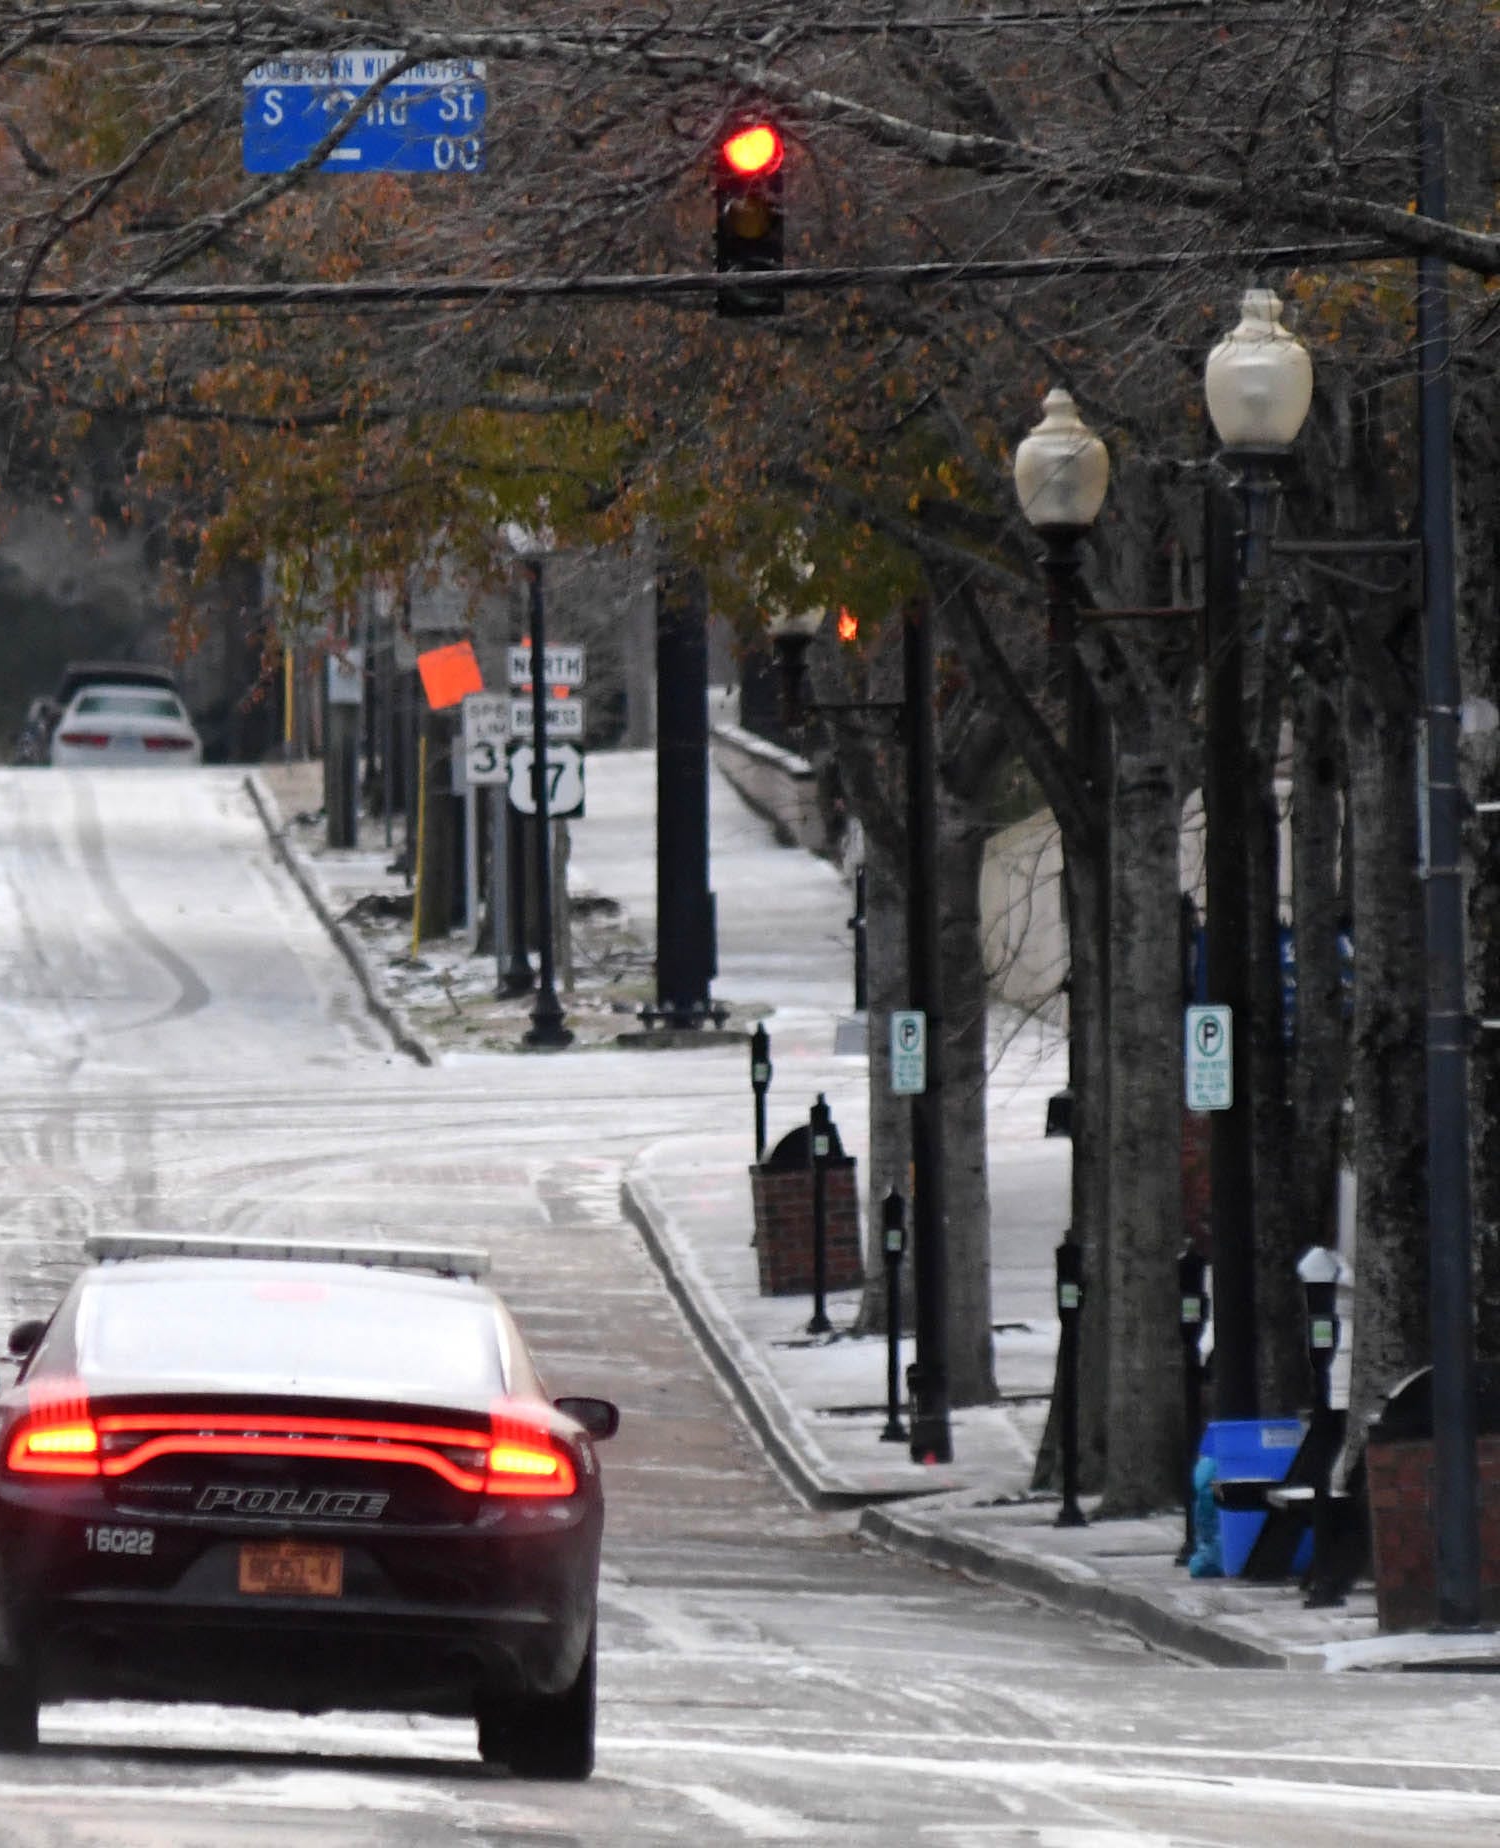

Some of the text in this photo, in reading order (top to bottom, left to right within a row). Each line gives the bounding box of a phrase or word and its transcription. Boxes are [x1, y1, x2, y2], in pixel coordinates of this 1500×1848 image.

[263, 89, 284, 126] S
[438, 88, 475, 122] St
[513, 656, 580, 676] NRTH
[1203, 1022, 1219, 1050] P
[196, 1486, 390, 1518] POLICE
[84, 1527, 155, 1556] 16022
